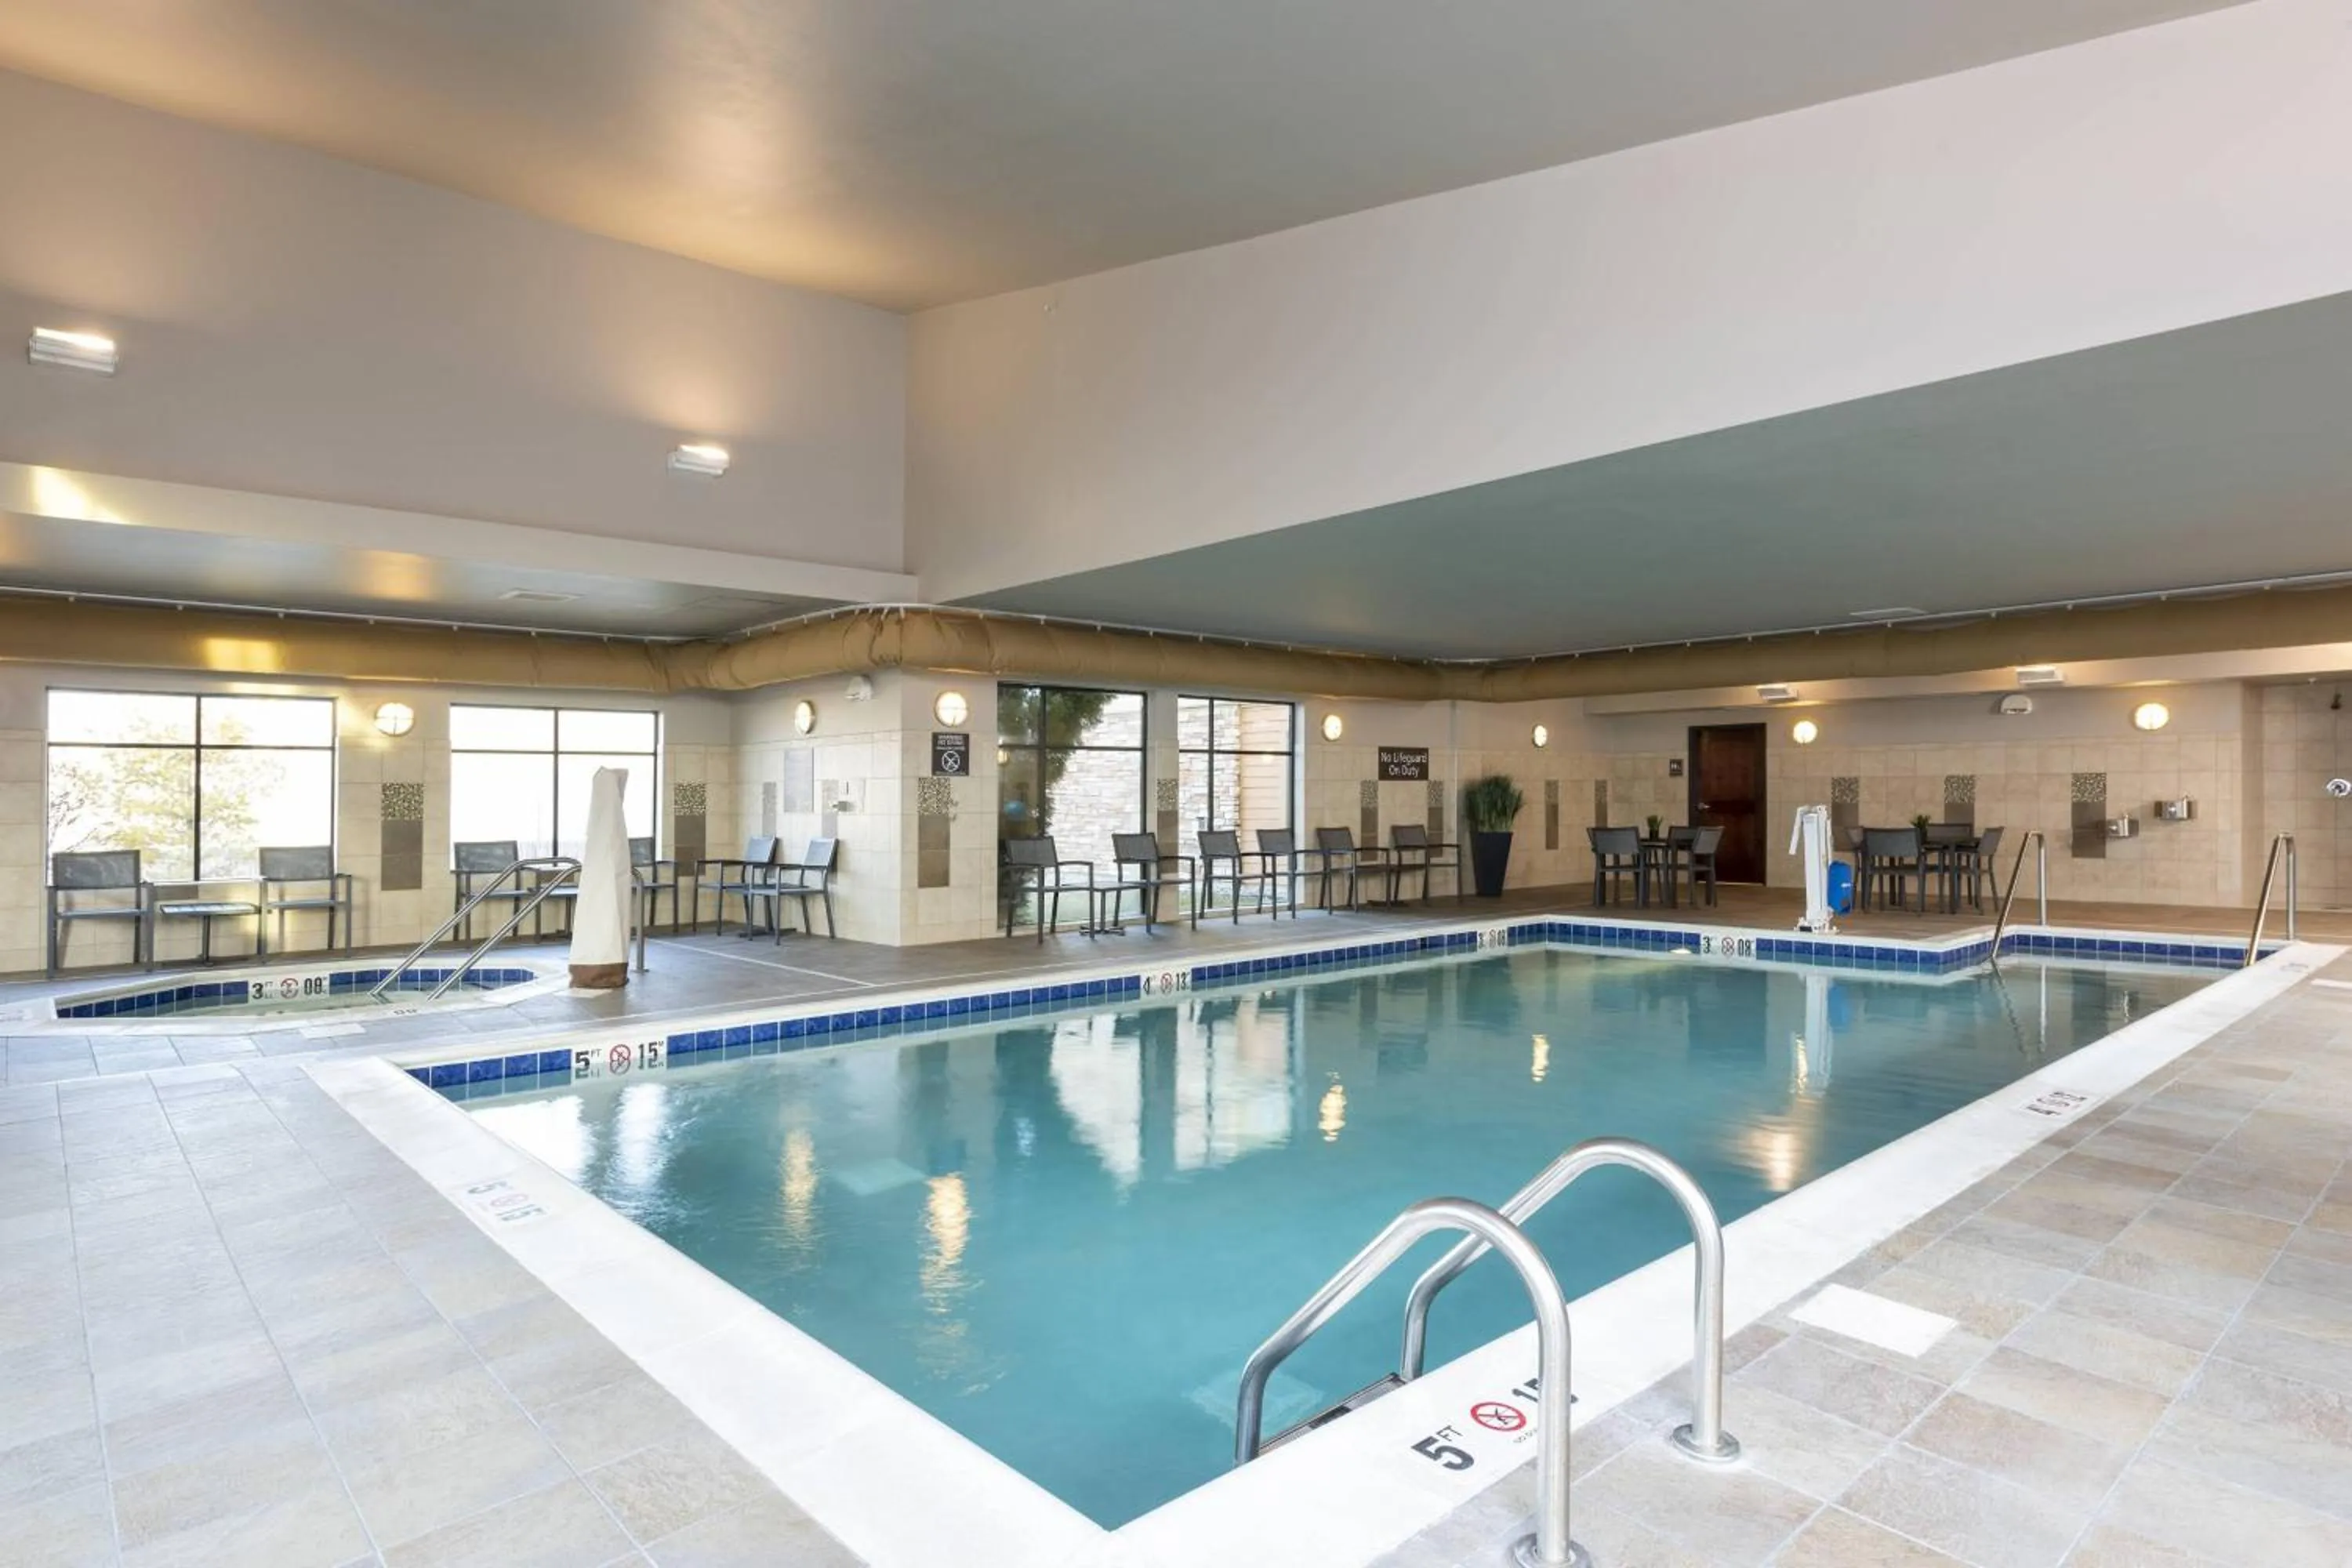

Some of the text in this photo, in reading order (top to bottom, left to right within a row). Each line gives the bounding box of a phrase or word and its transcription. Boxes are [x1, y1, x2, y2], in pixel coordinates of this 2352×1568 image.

[1381, 752, 1428, 765] No Lifeguard
[1388, 764, 1419, 778] On Duty
[575, 1050, 590, 1073] 5
[1436, 1424, 1465, 1442] FT
[1410, 1436, 1475, 1471] 5
